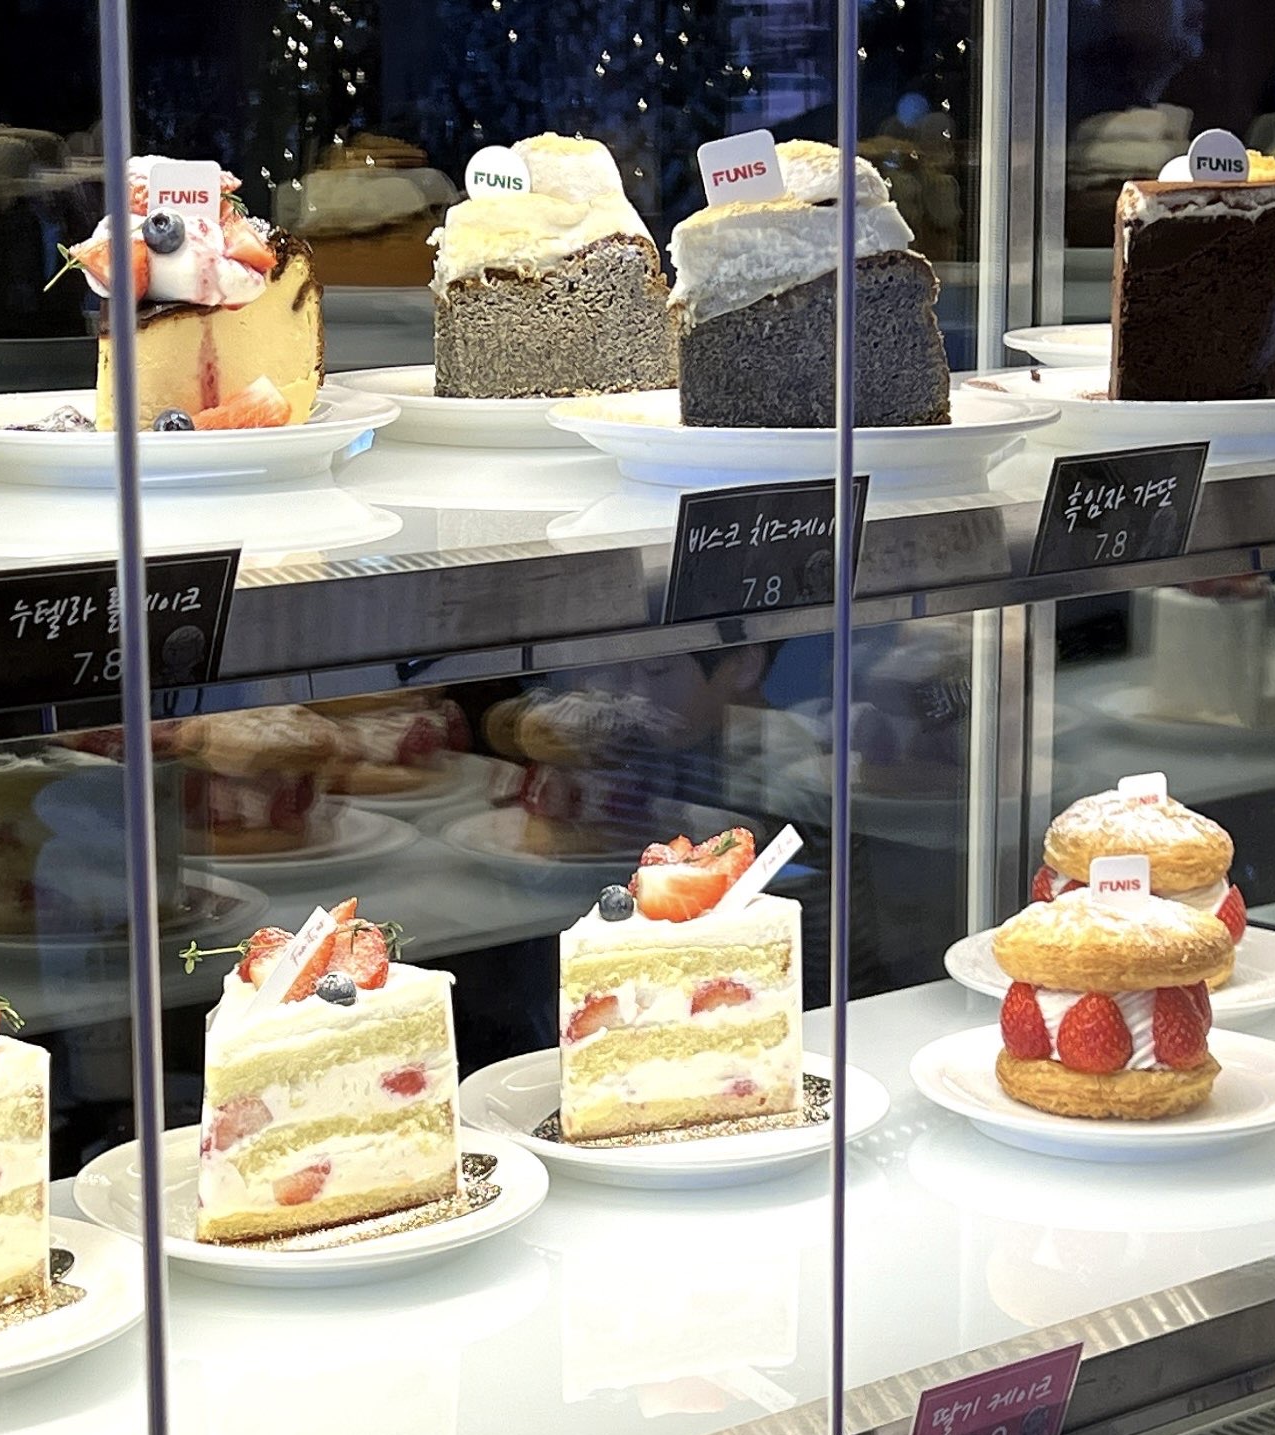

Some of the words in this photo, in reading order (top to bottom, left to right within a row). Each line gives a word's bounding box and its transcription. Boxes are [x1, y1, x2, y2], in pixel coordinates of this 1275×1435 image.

[474, 171, 523, 191] FUNIS
[712, 161, 767, 187] FUNIS
[1196, 156, 1244, 174] FUNIS
[159, 190, 209, 204] FUNIS
[1064, 481, 1126, 533] 흑임자
[688, 522, 741, 554] 바스크
[749, 513, 836, 547] 치즈케이
[1094, 530, 1128, 561] 7.8
[742, 575, 783, 608] 7.8
[9, 595, 96, 640] 누텔라
[73, 649, 124, 685] 7.8
[1099, 879, 1141, 893] FUNIS
[987, 1374, 1052, 1412] 케이크
